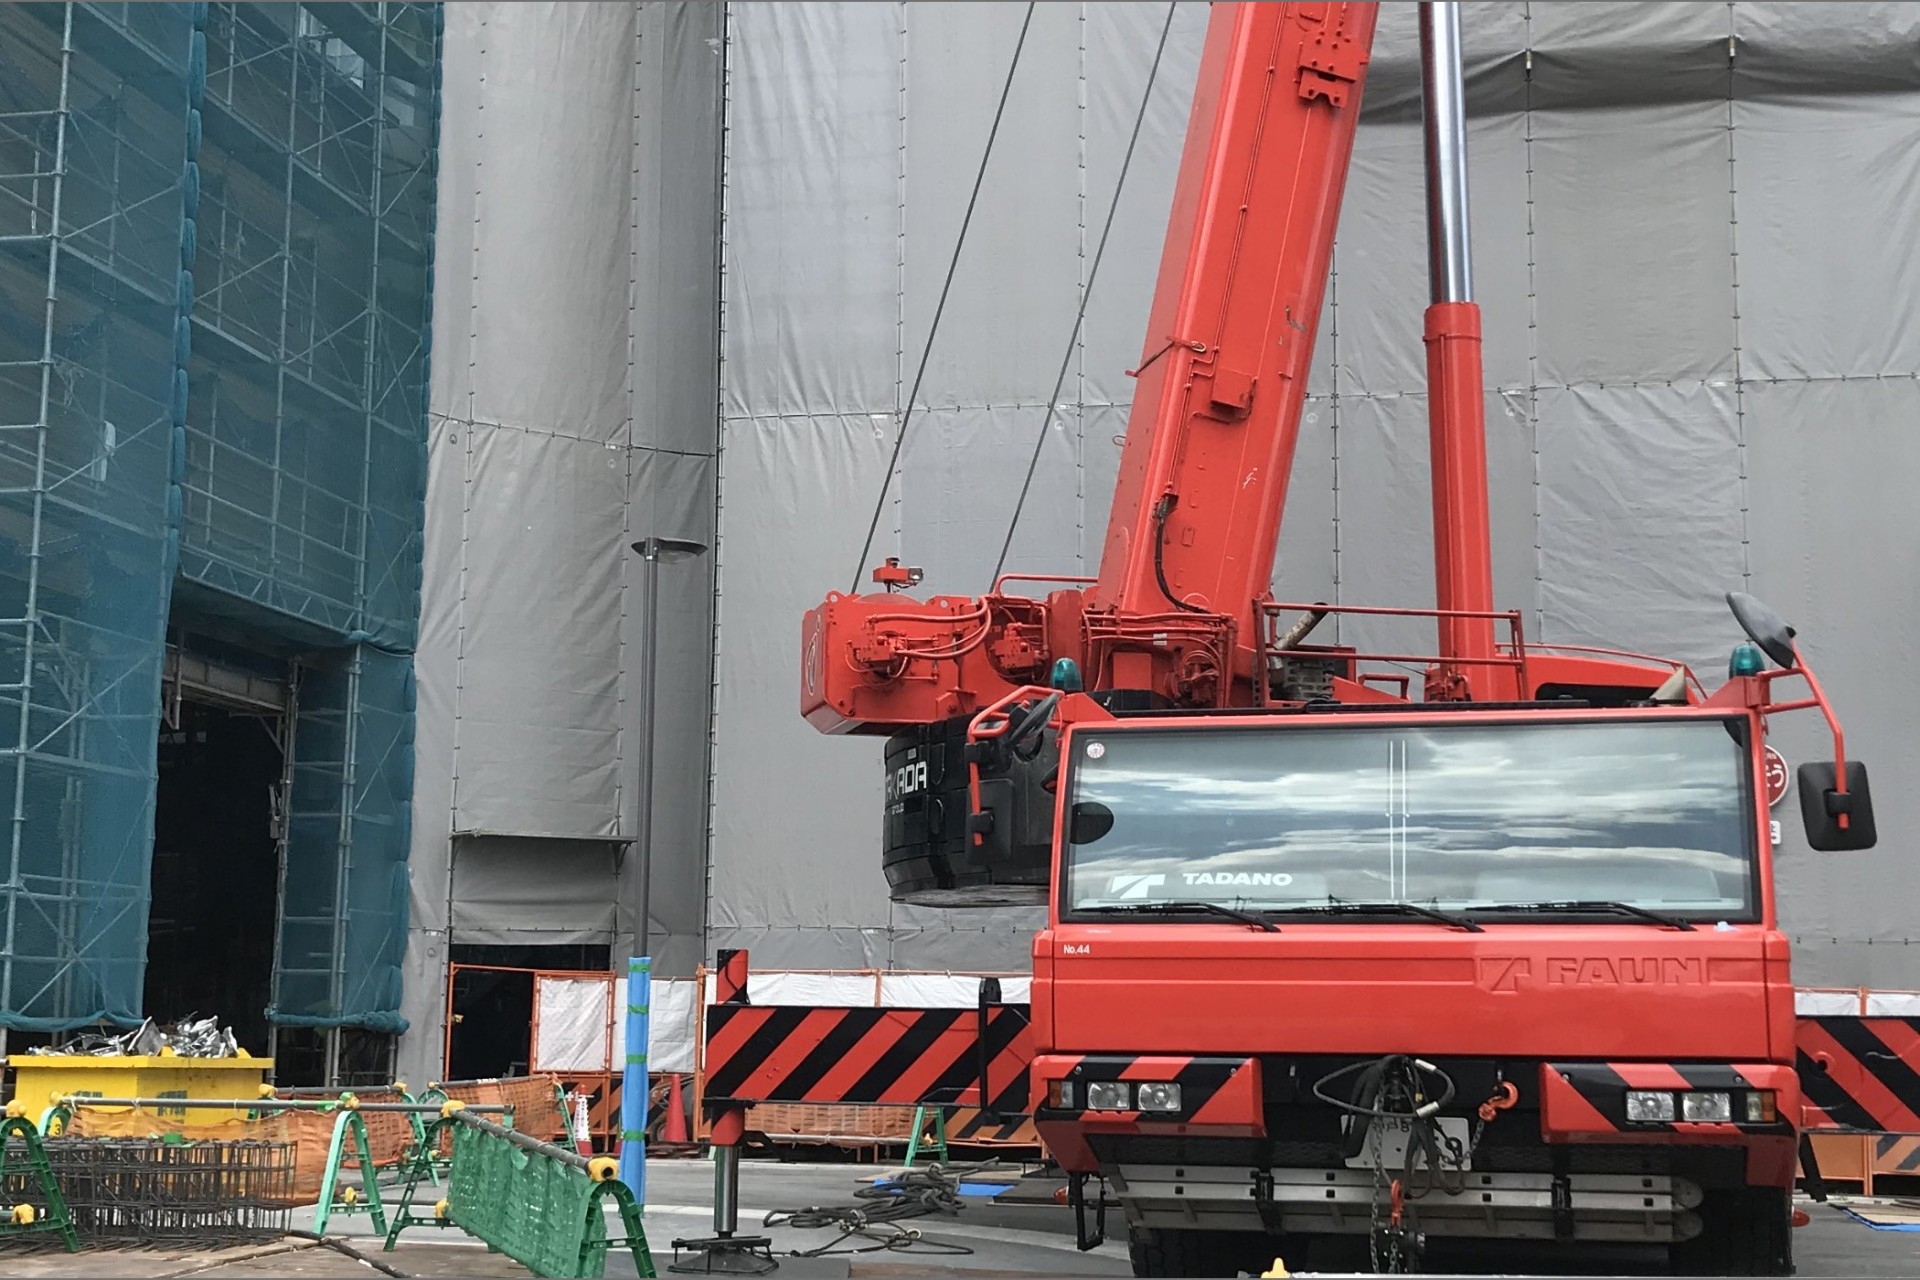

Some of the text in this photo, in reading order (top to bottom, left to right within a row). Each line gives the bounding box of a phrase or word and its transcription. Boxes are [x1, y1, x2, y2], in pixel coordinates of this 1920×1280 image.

[1183, 872, 1293, 886] TADANO
[1064, 944, 1090, 955] No.44
[1547, 957, 1702, 985] FAUN
